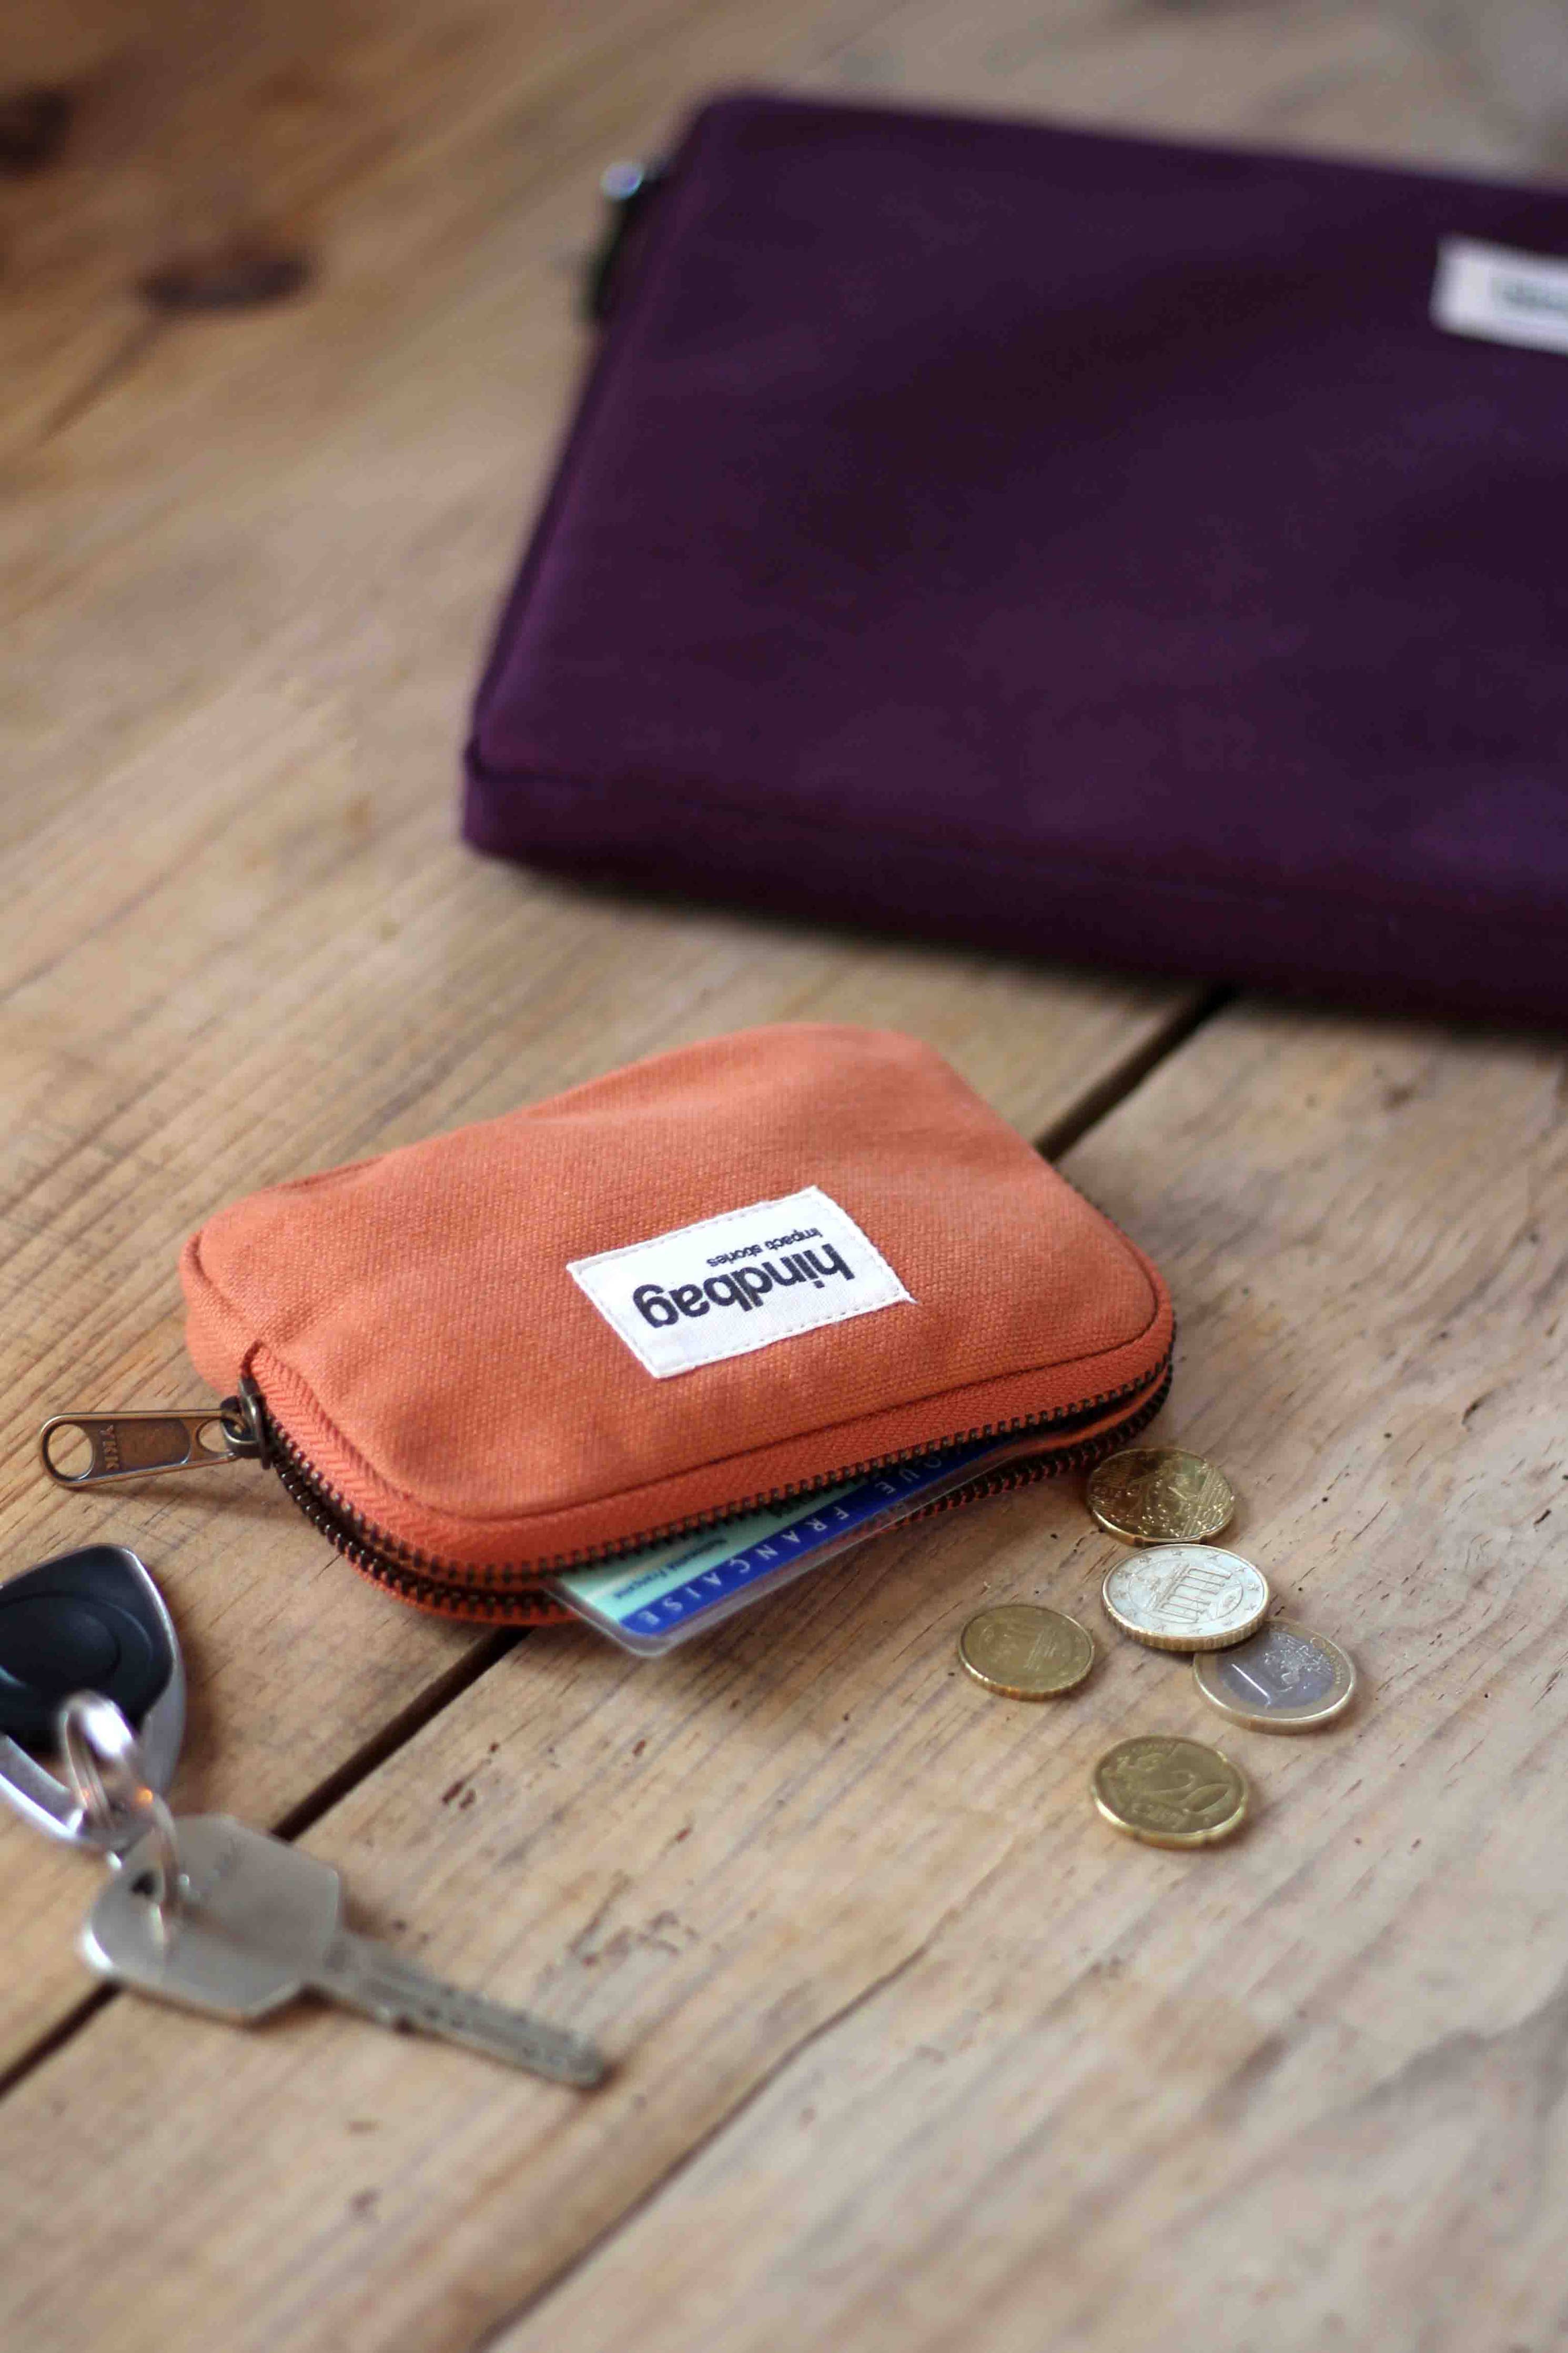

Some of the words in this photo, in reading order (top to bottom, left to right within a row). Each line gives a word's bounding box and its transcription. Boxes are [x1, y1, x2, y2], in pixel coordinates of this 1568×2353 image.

[632, 1243, 855, 1328] hindbag
[706, 1244, 763, 1267] stories
[637, 1505, 849, 1626] FRANÇAISE
